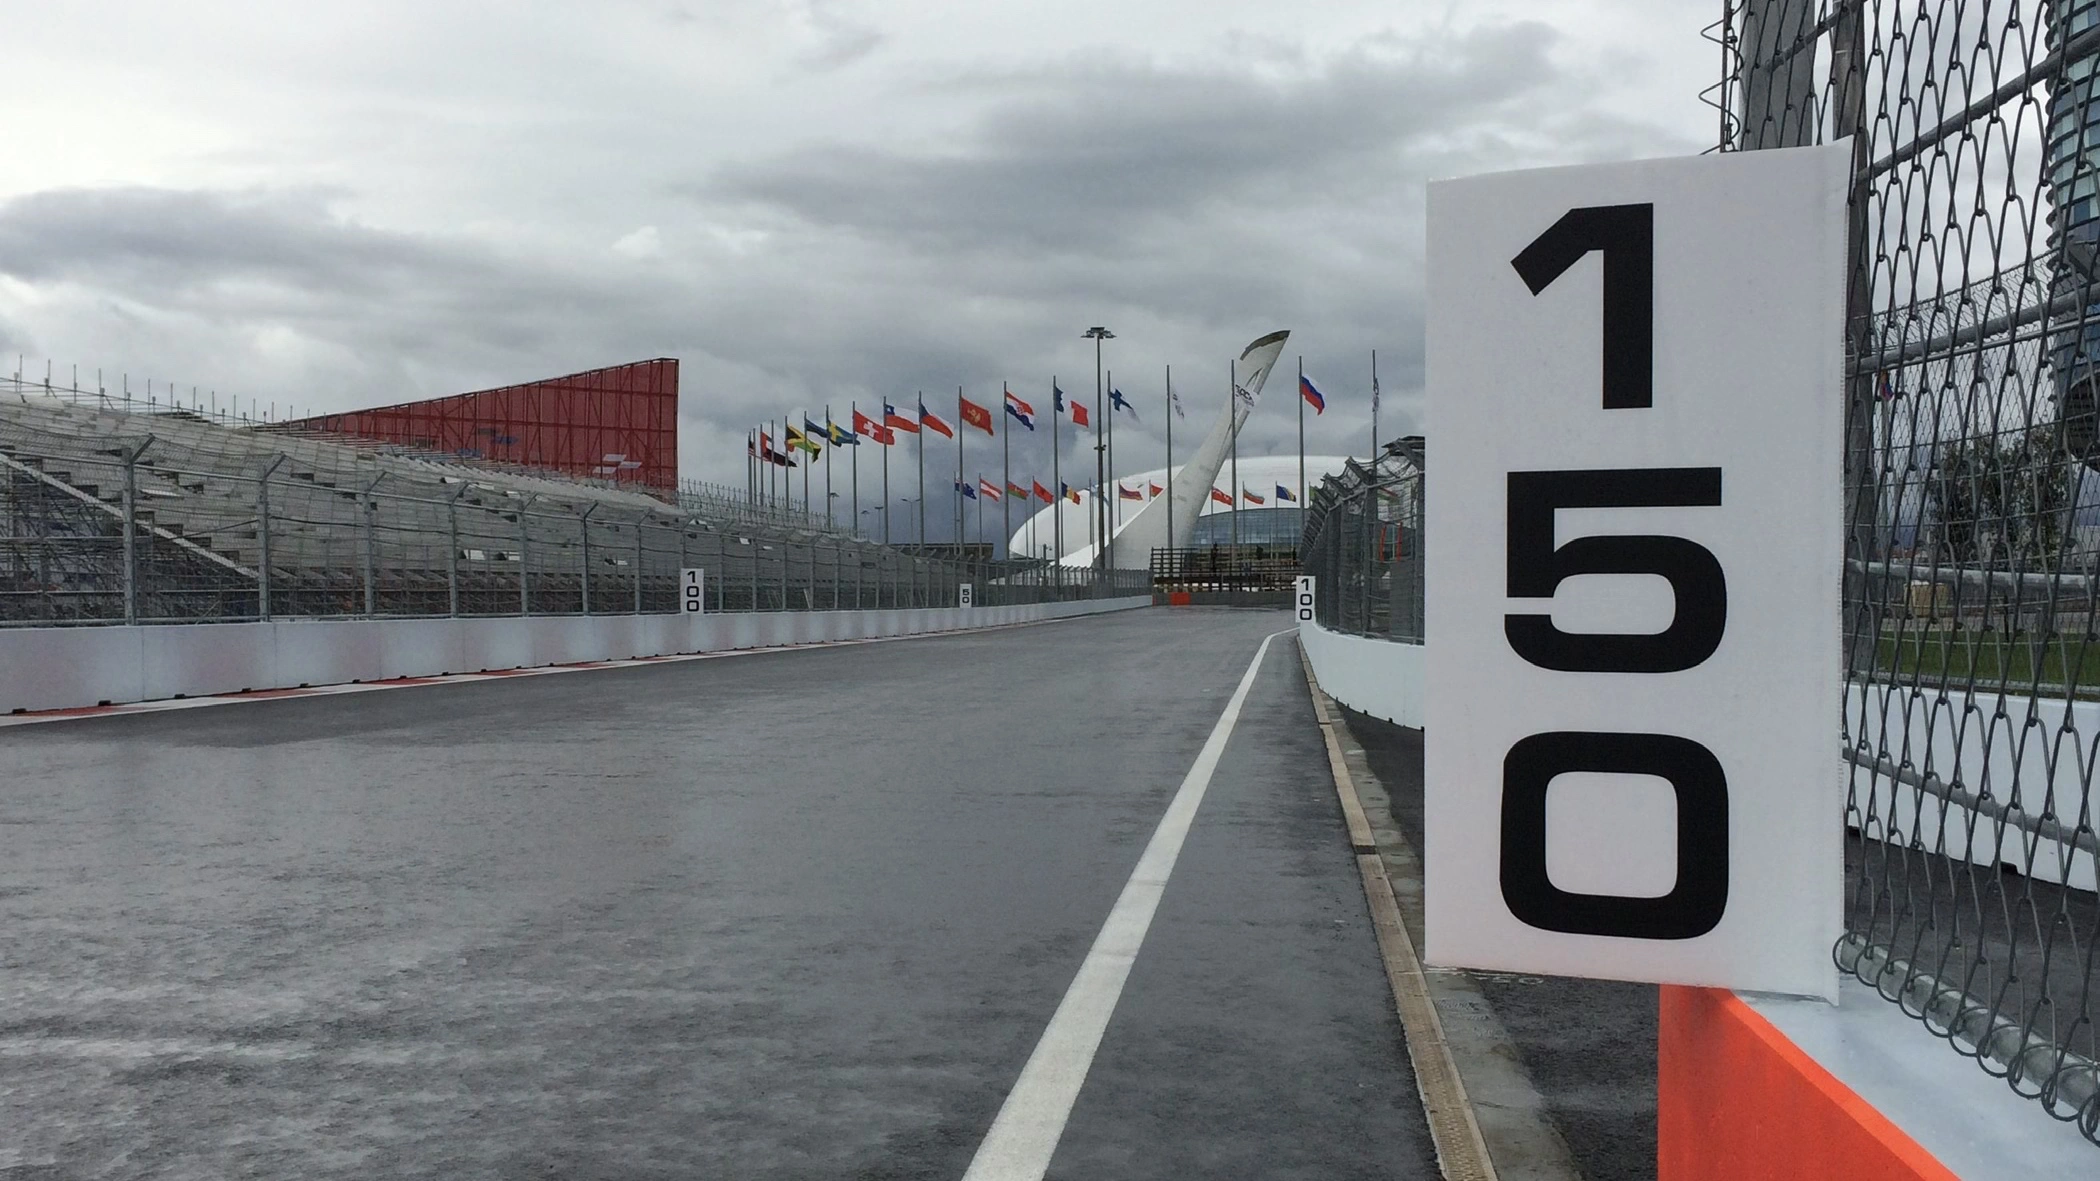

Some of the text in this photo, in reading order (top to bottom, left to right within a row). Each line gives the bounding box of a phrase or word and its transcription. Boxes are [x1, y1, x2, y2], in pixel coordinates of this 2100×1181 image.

[686, 571, 700, 612] 100
[1500, 203, 1729, 940] 150
[962, 589, 970, 604] 50
[1300, 578, 1312, 621] 100
